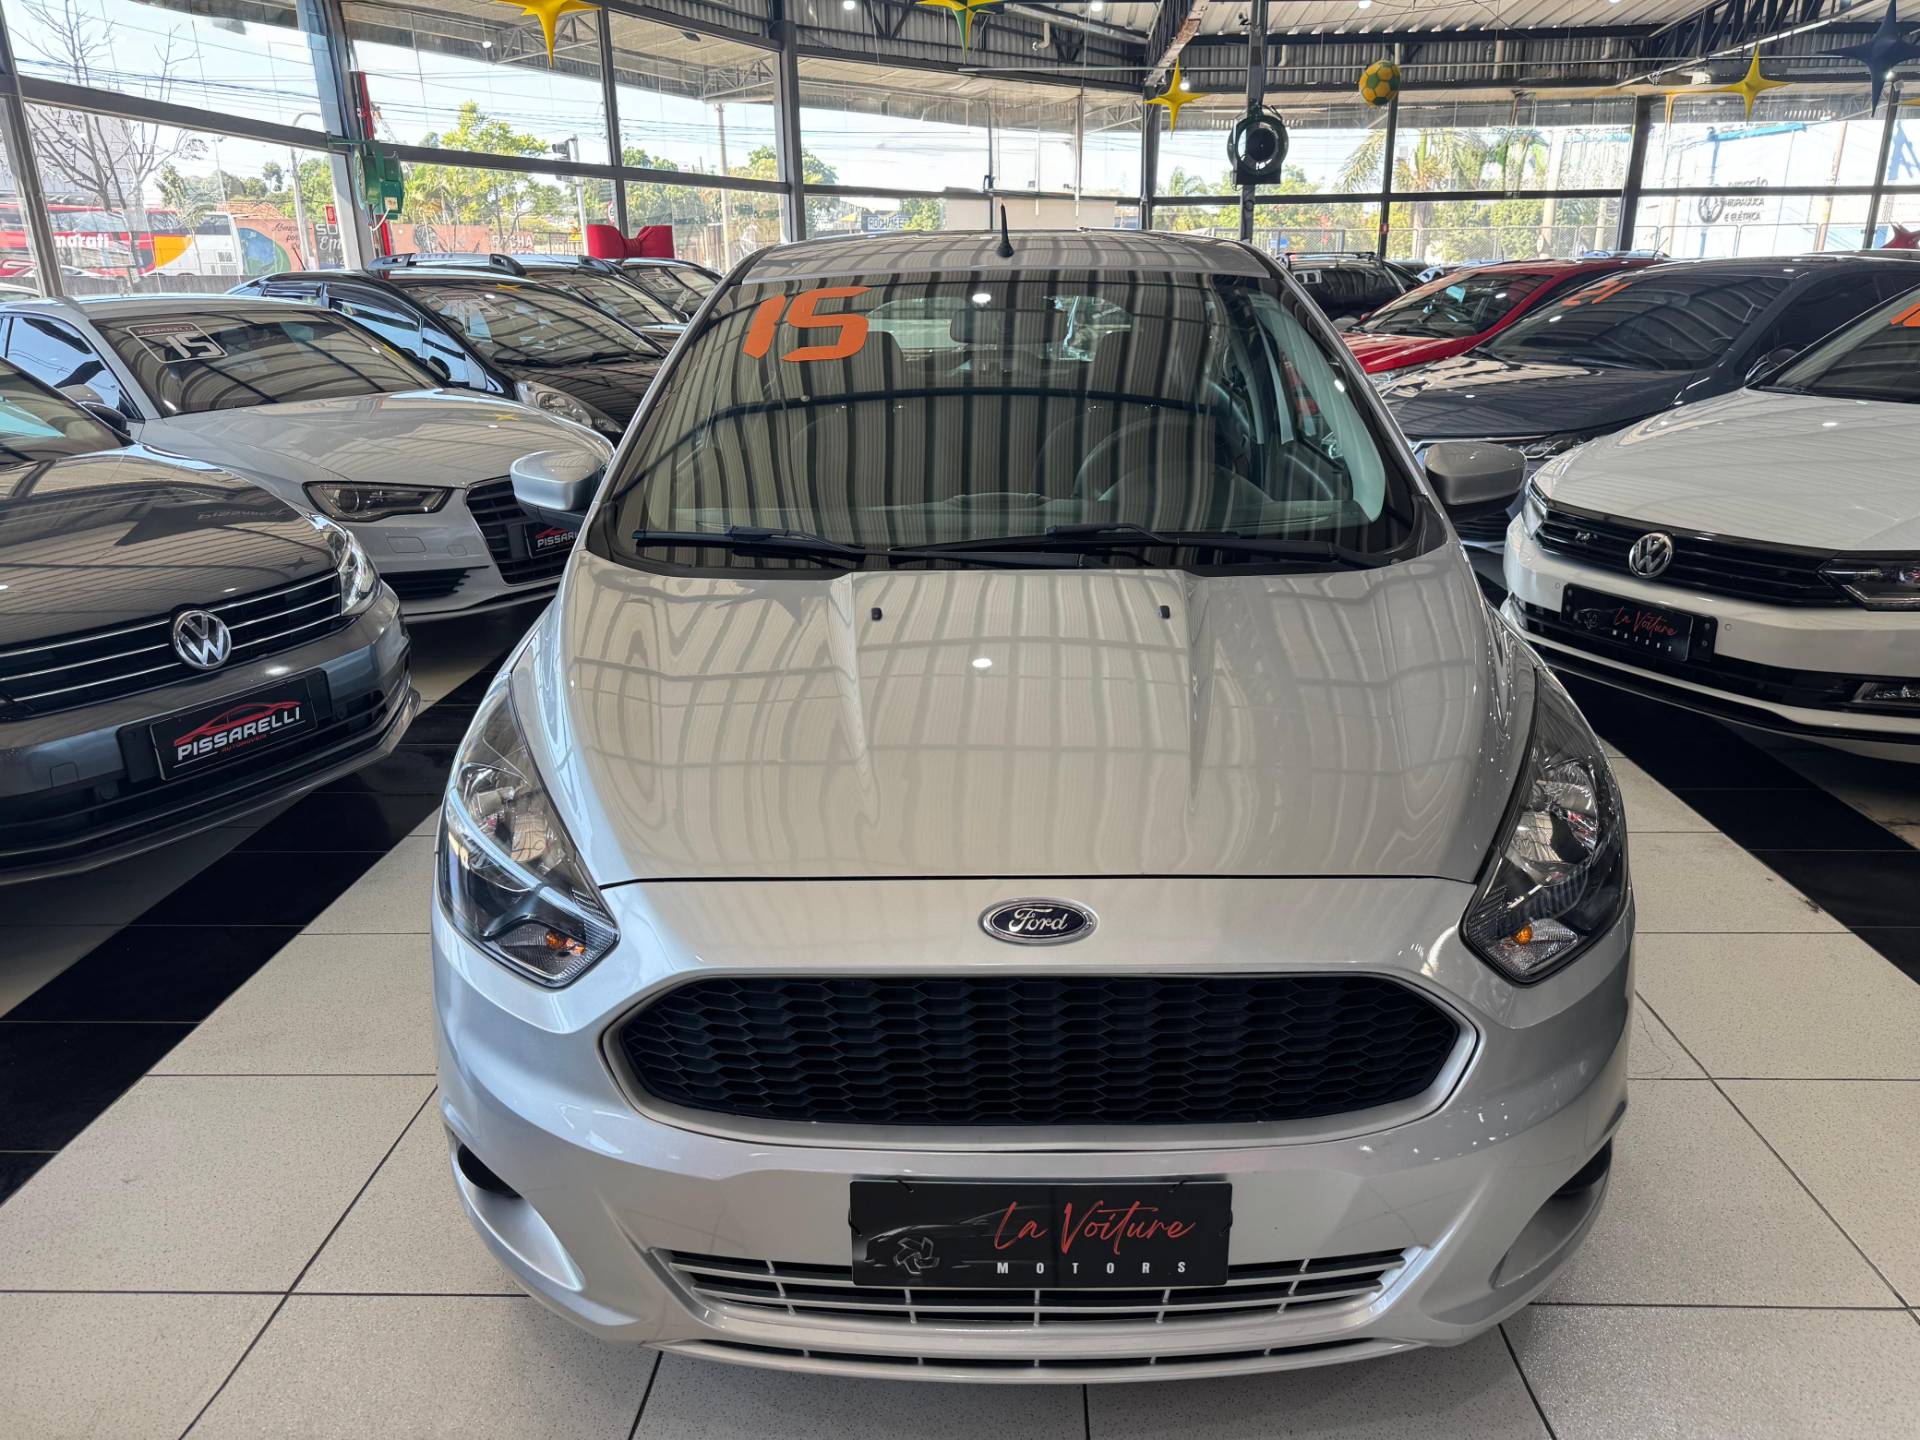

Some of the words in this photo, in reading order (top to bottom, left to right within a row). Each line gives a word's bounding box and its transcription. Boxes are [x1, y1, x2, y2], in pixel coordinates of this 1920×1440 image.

[743, 286, 873, 362] 15
[177, 706, 300, 761] PISSARELLI
[1008, 907, 1068, 933] Ford
[993, 1200, 1049, 1251] La
[1060, 1200, 1197, 1256] Voiture
[996, 1260, 1187, 1275] MOTORS
